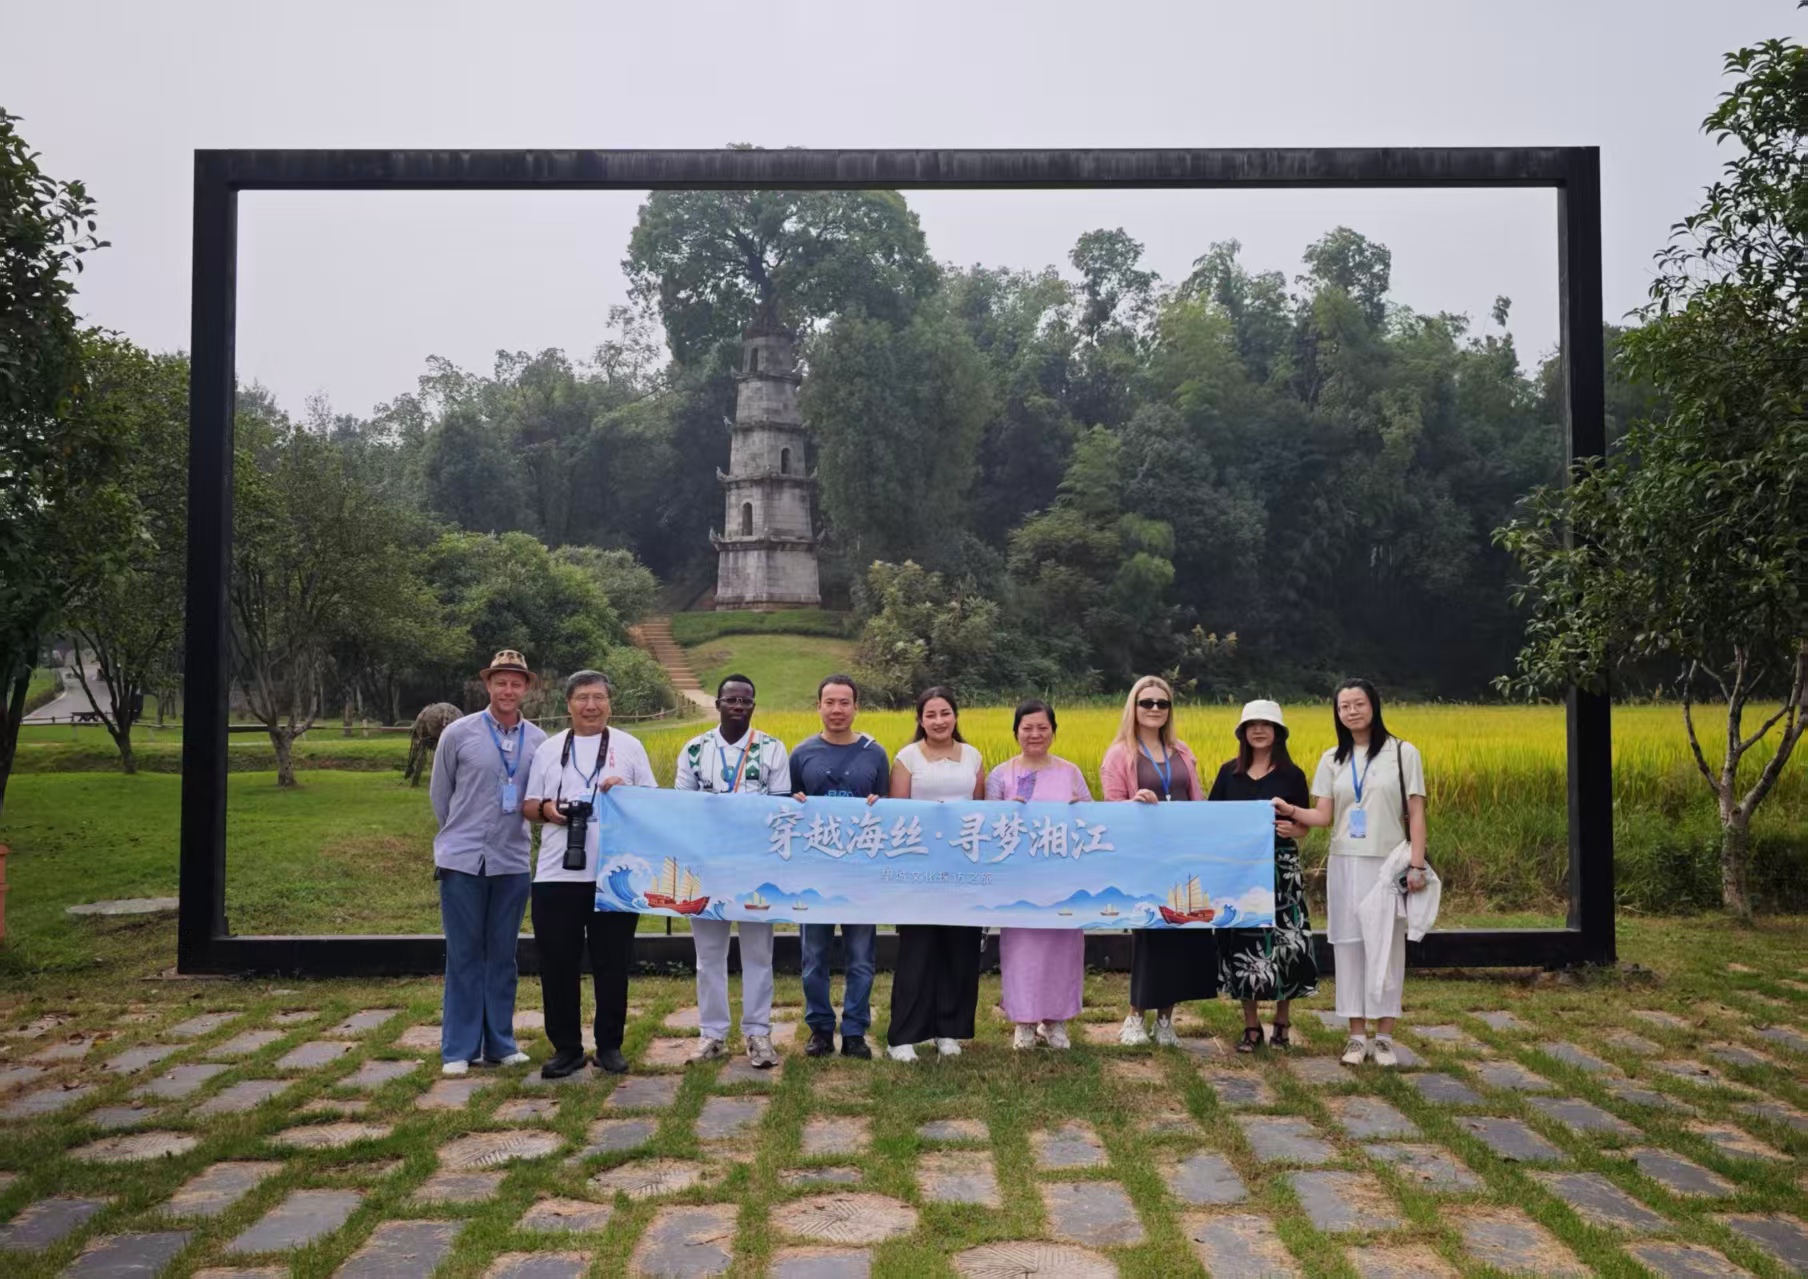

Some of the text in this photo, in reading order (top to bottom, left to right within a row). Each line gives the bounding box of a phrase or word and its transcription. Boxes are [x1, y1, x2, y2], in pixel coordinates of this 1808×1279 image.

[766, 808, 1115, 863] 穿越海丝·寻梦湘江
